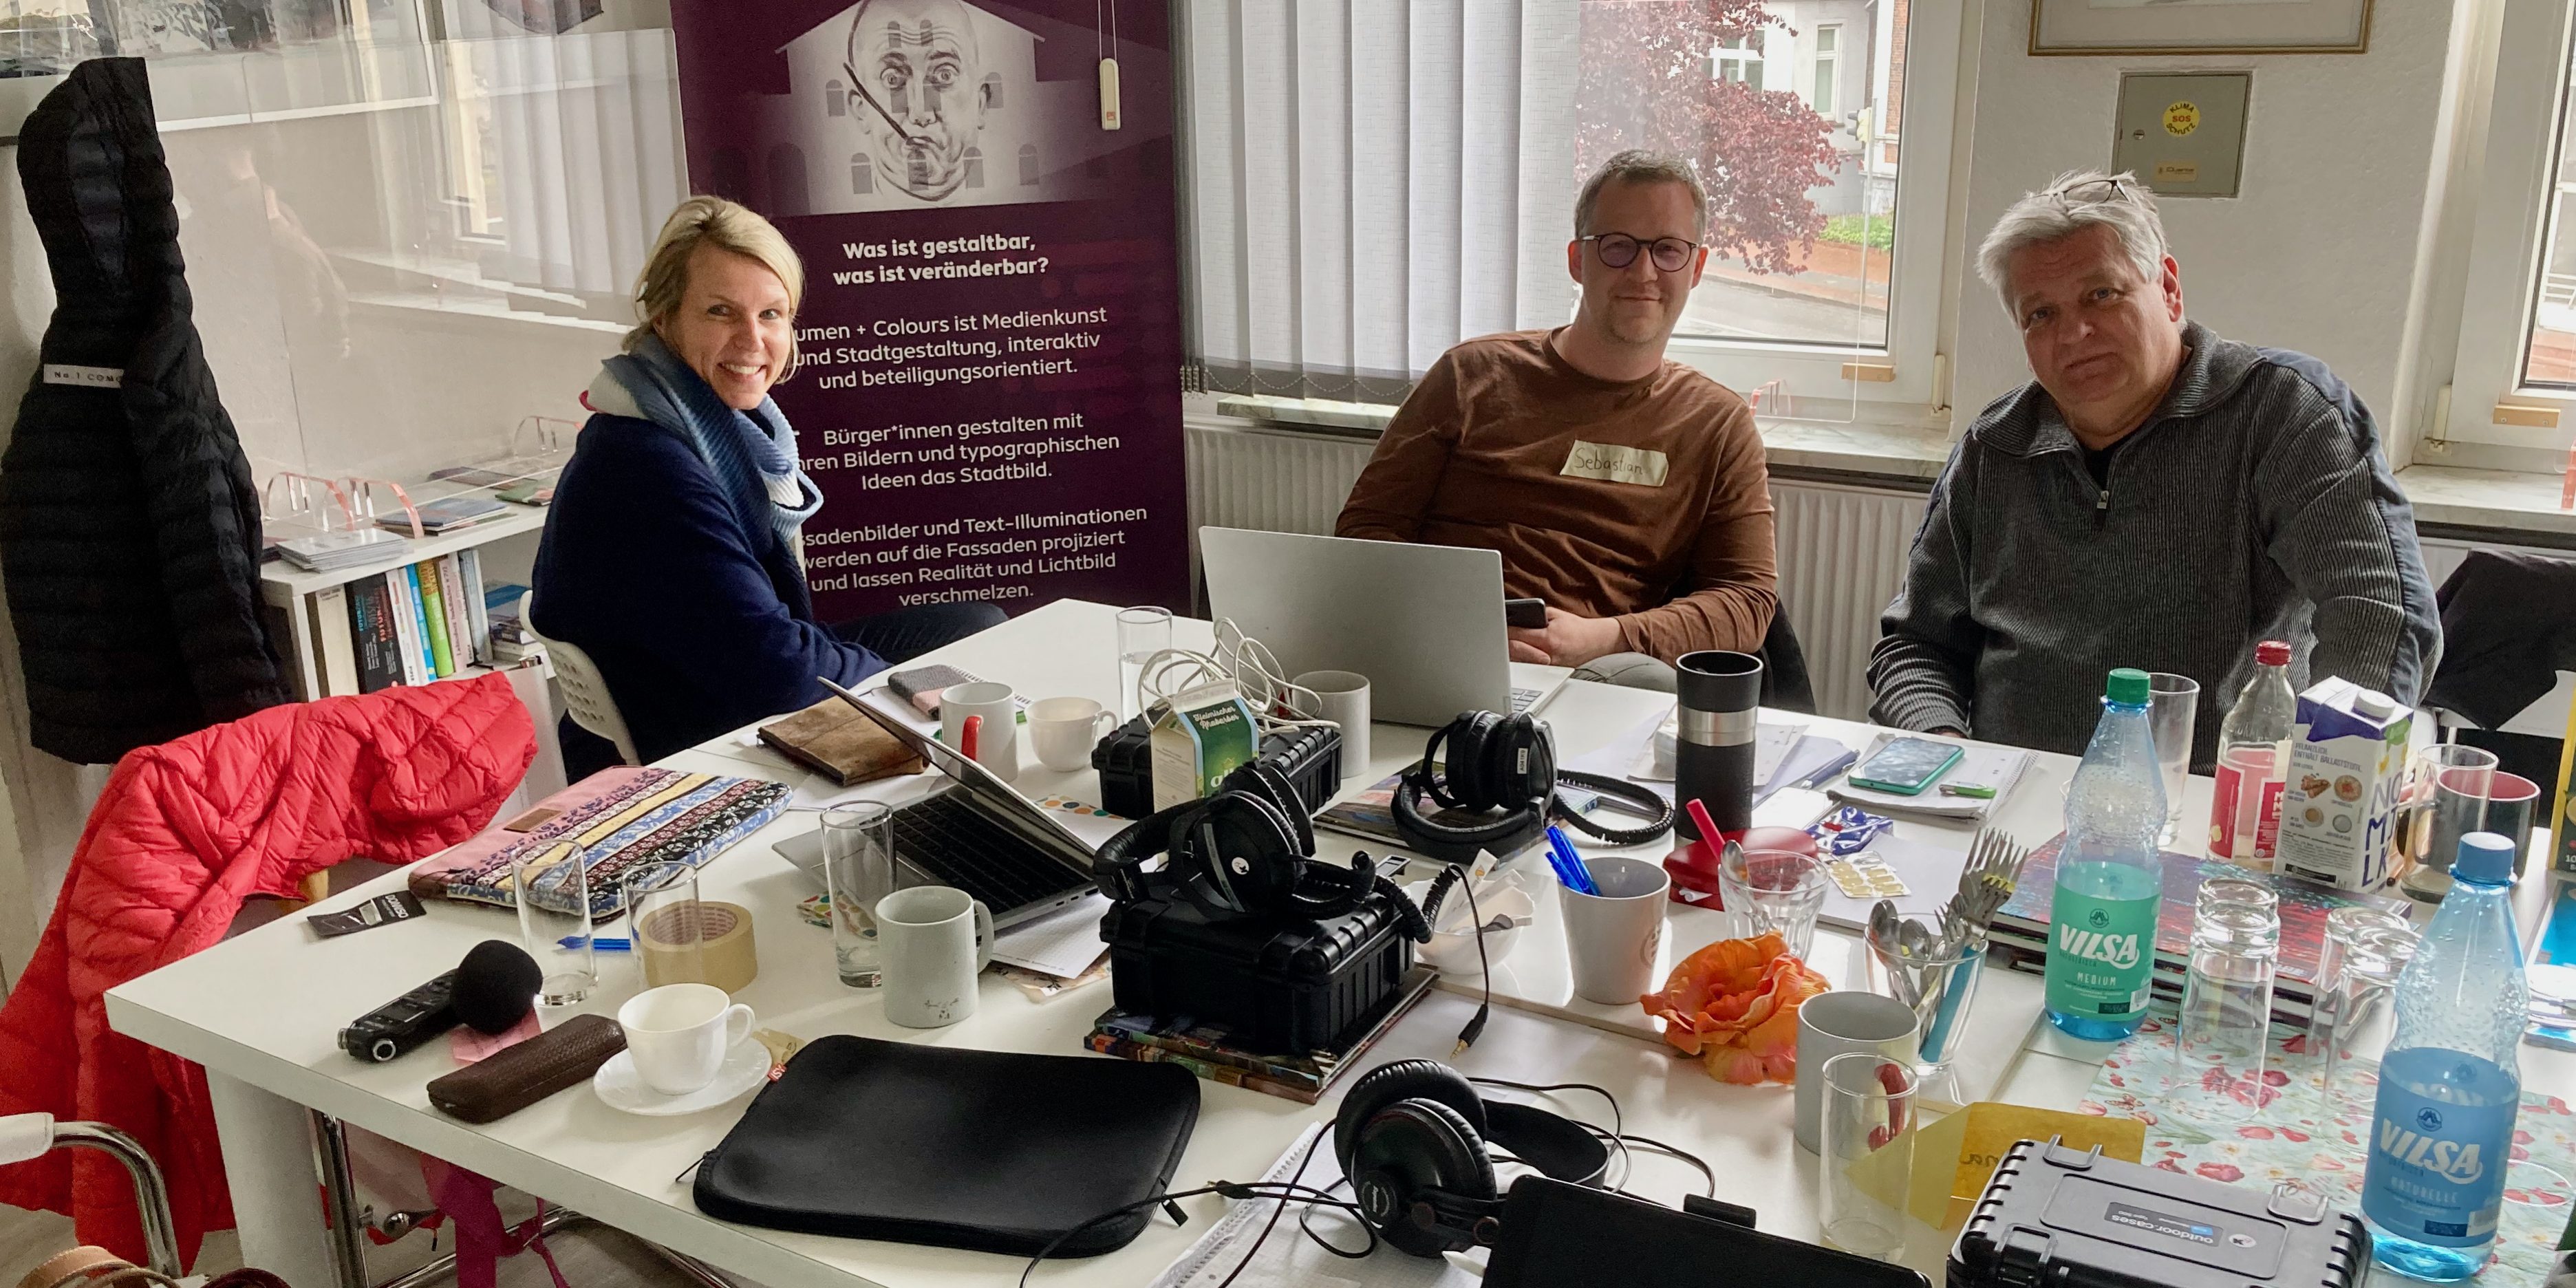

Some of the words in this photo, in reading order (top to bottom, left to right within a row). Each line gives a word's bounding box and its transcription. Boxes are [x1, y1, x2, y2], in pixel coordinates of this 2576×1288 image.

[2170, 103, 2194, 113] KLIMA
[2166, 122, 2196, 135] SCHUTZ
[843, 241, 888, 259] Was
[892, 239, 918, 256] ist
[923, 234, 1035, 259] gestaltbar,
[833, 270, 874, 284] was
[879, 266, 905, 281] ist
[909, 257, 1049, 280] veränderbar?
[795, 326, 850, 341] umen
[857, 325, 866, 334] +
[874, 319, 949, 336] Colours
[954, 316, 978, 331] ist
[983, 308, 1107, 329] Medienkunst
[837, 341, 1002, 363] Stadtgestaltung,
[1009, 332, 1099, 352] interaktiv
[819, 371, 856, 389] und
[862, 358, 1077, 386] beteiligungsorientiert.
[958, 417, 1047, 440] gestalten
[1053, 414, 1083, 429] mit
[799, 458, 838, 471] ren
[844, 450, 912, 467] Bildern
[919, 444, 954, 461] und
[960, 436, 1119, 462] typographischen
[1574, 448, 1643, 475] Sebastian
[863, 474, 915, 489] Ideen
[921, 470, 955, 484] das
[960, 462, 1051, 482] Stadtbild.
[802, 524, 919, 546] sadenbilder
[924, 519, 959, 535] und
[964, 509, 1146, 533] Text-Illuminationen
[877, 546, 908, 562] auf
[914, 545, 941, 559] die
[947, 538, 1036, 557] Fassaden
[1042, 531, 1125, 554] projiziert
[812, 575, 847, 591] und
[853, 572, 912, 588] lassen
[919, 564, 993, 581] Realität
[998, 559, 1032, 575] und
[1039, 552, 1115, 572] Lichtbild
[899, 585, 1033, 605] verschmelzen.
[1192, 706, 1236, 721] Heimischer
[1199, 714, 1239, 731] Rhabarber
[385, 894, 409, 918] DOMISO
[2059, 923, 2140, 969] VILSA
[2076, 972, 2116, 986] MEDIUM
[2380, 1117, 2482, 1185] VILSA
[2391, 1175, 2458, 1203] NATURELLE
[2112, 1214, 2213, 1244] outdoor.cases
